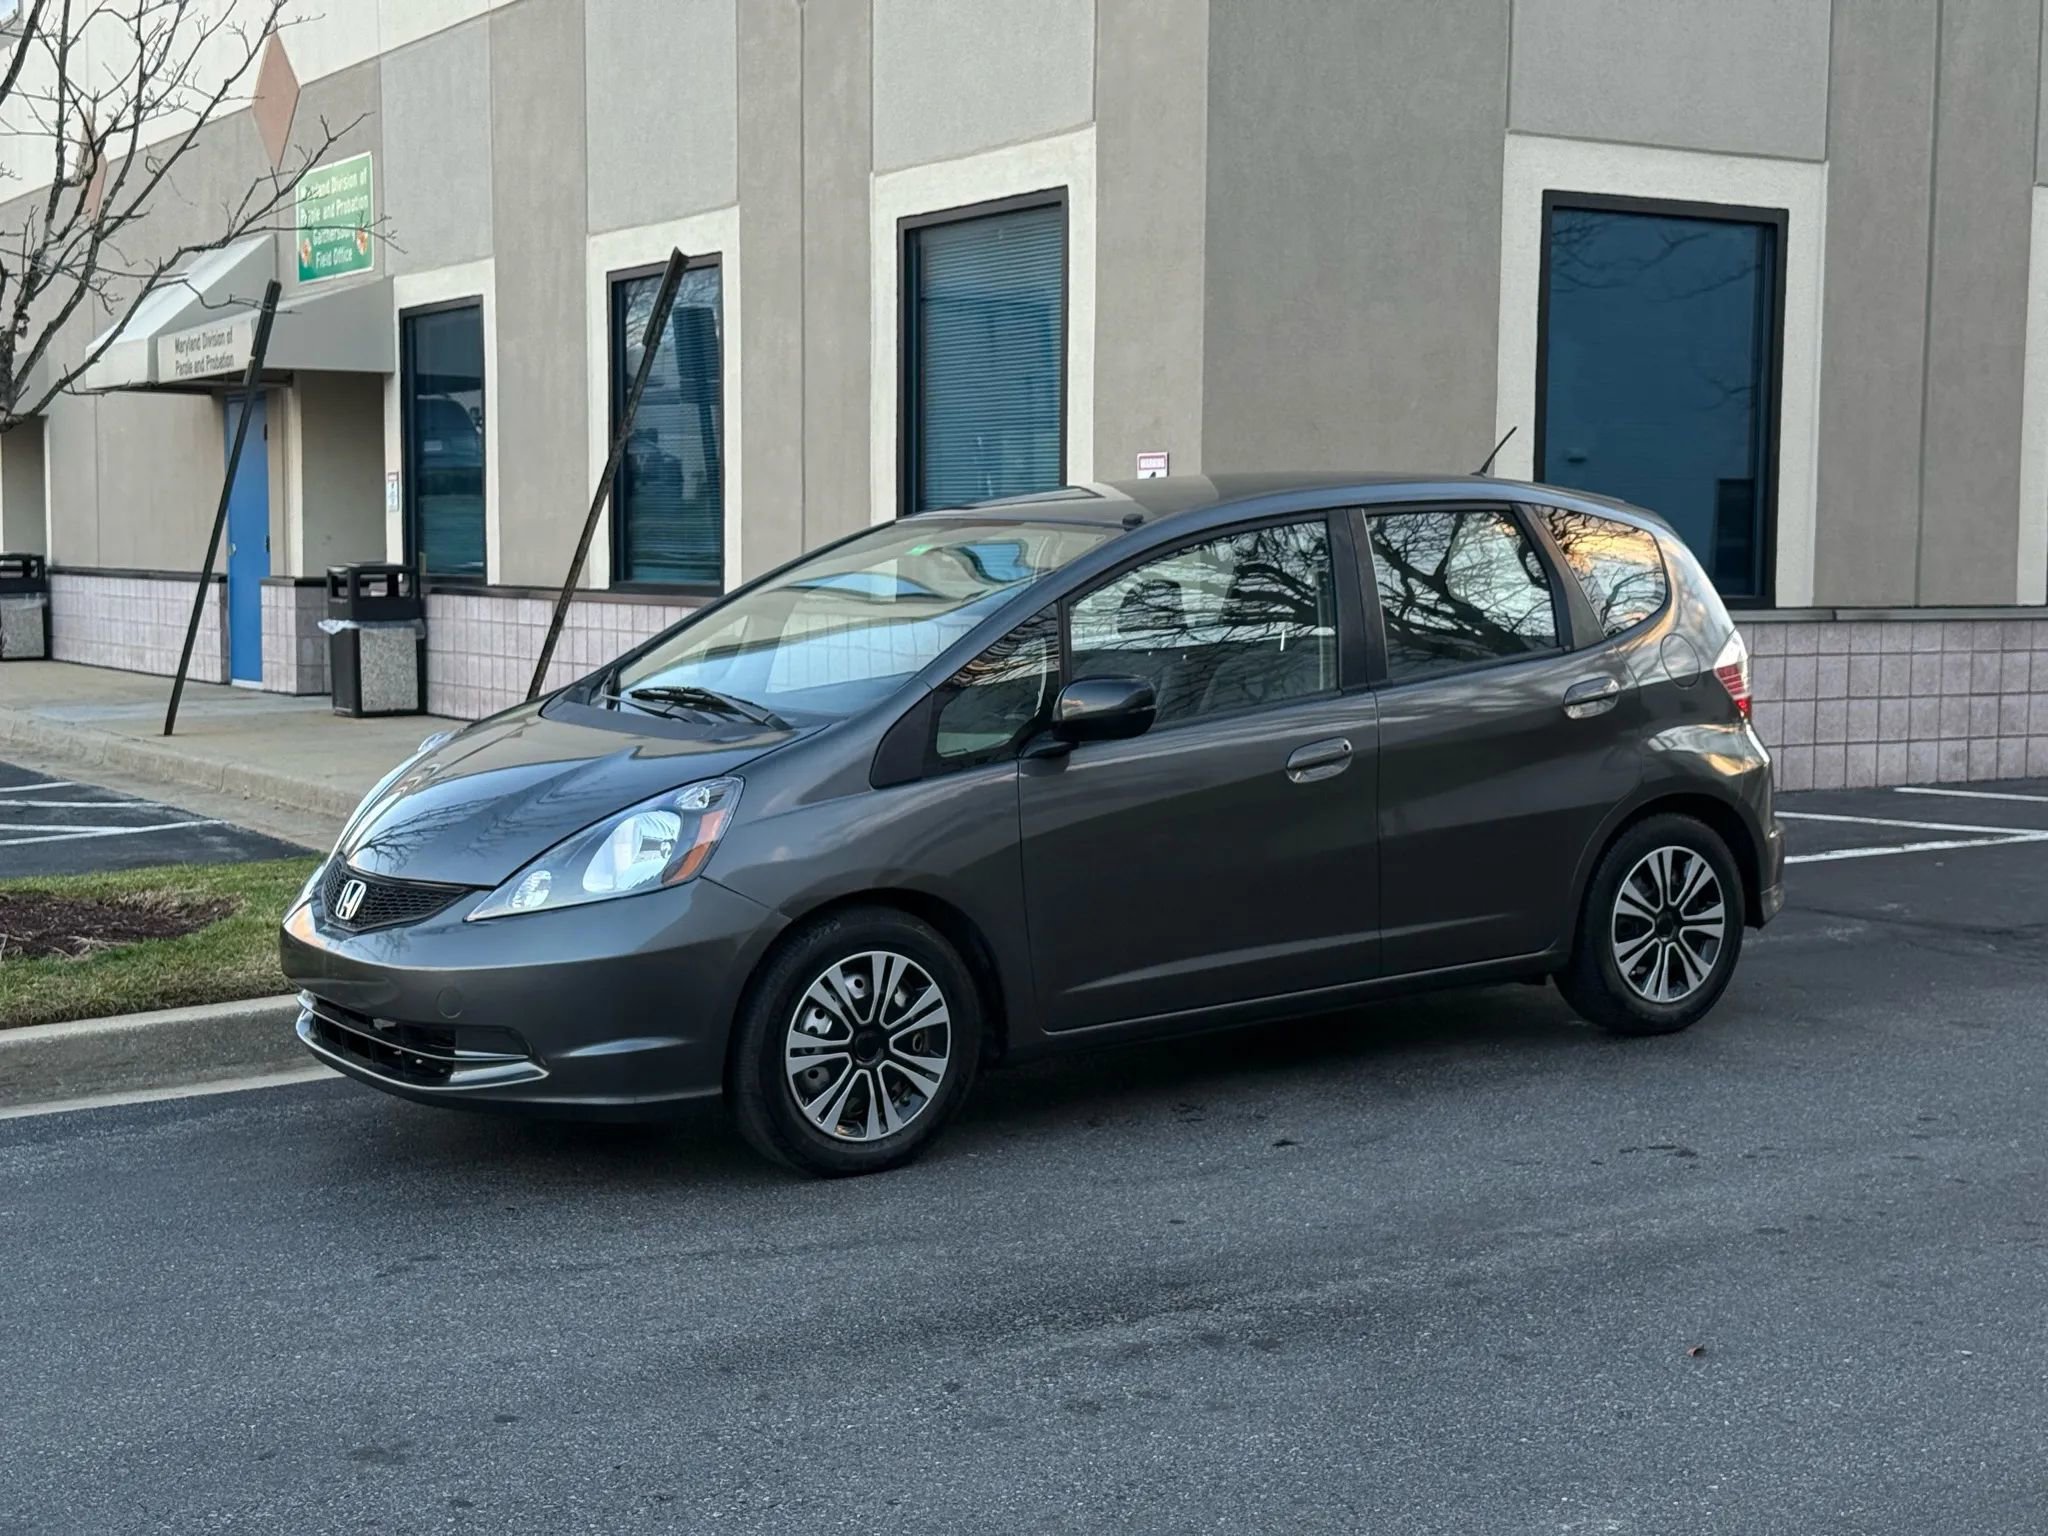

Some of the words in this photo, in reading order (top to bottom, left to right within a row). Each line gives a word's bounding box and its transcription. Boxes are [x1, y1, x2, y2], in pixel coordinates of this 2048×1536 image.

[332, 173, 357, 194] Division
[360, 167, 367, 185] of
[323, 202, 335, 219] and
[336, 195, 368, 215] Probation
[316, 250, 333, 270] Field
[333, 246, 352, 264] Office
[175, 335, 200, 356] Maryland
[202, 331, 225, 349] Division
[226, 325, 233, 345] of
[176, 358, 193, 377] Parole
[194, 356, 205, 374] and
[206, 352, 234, 371] Probation
